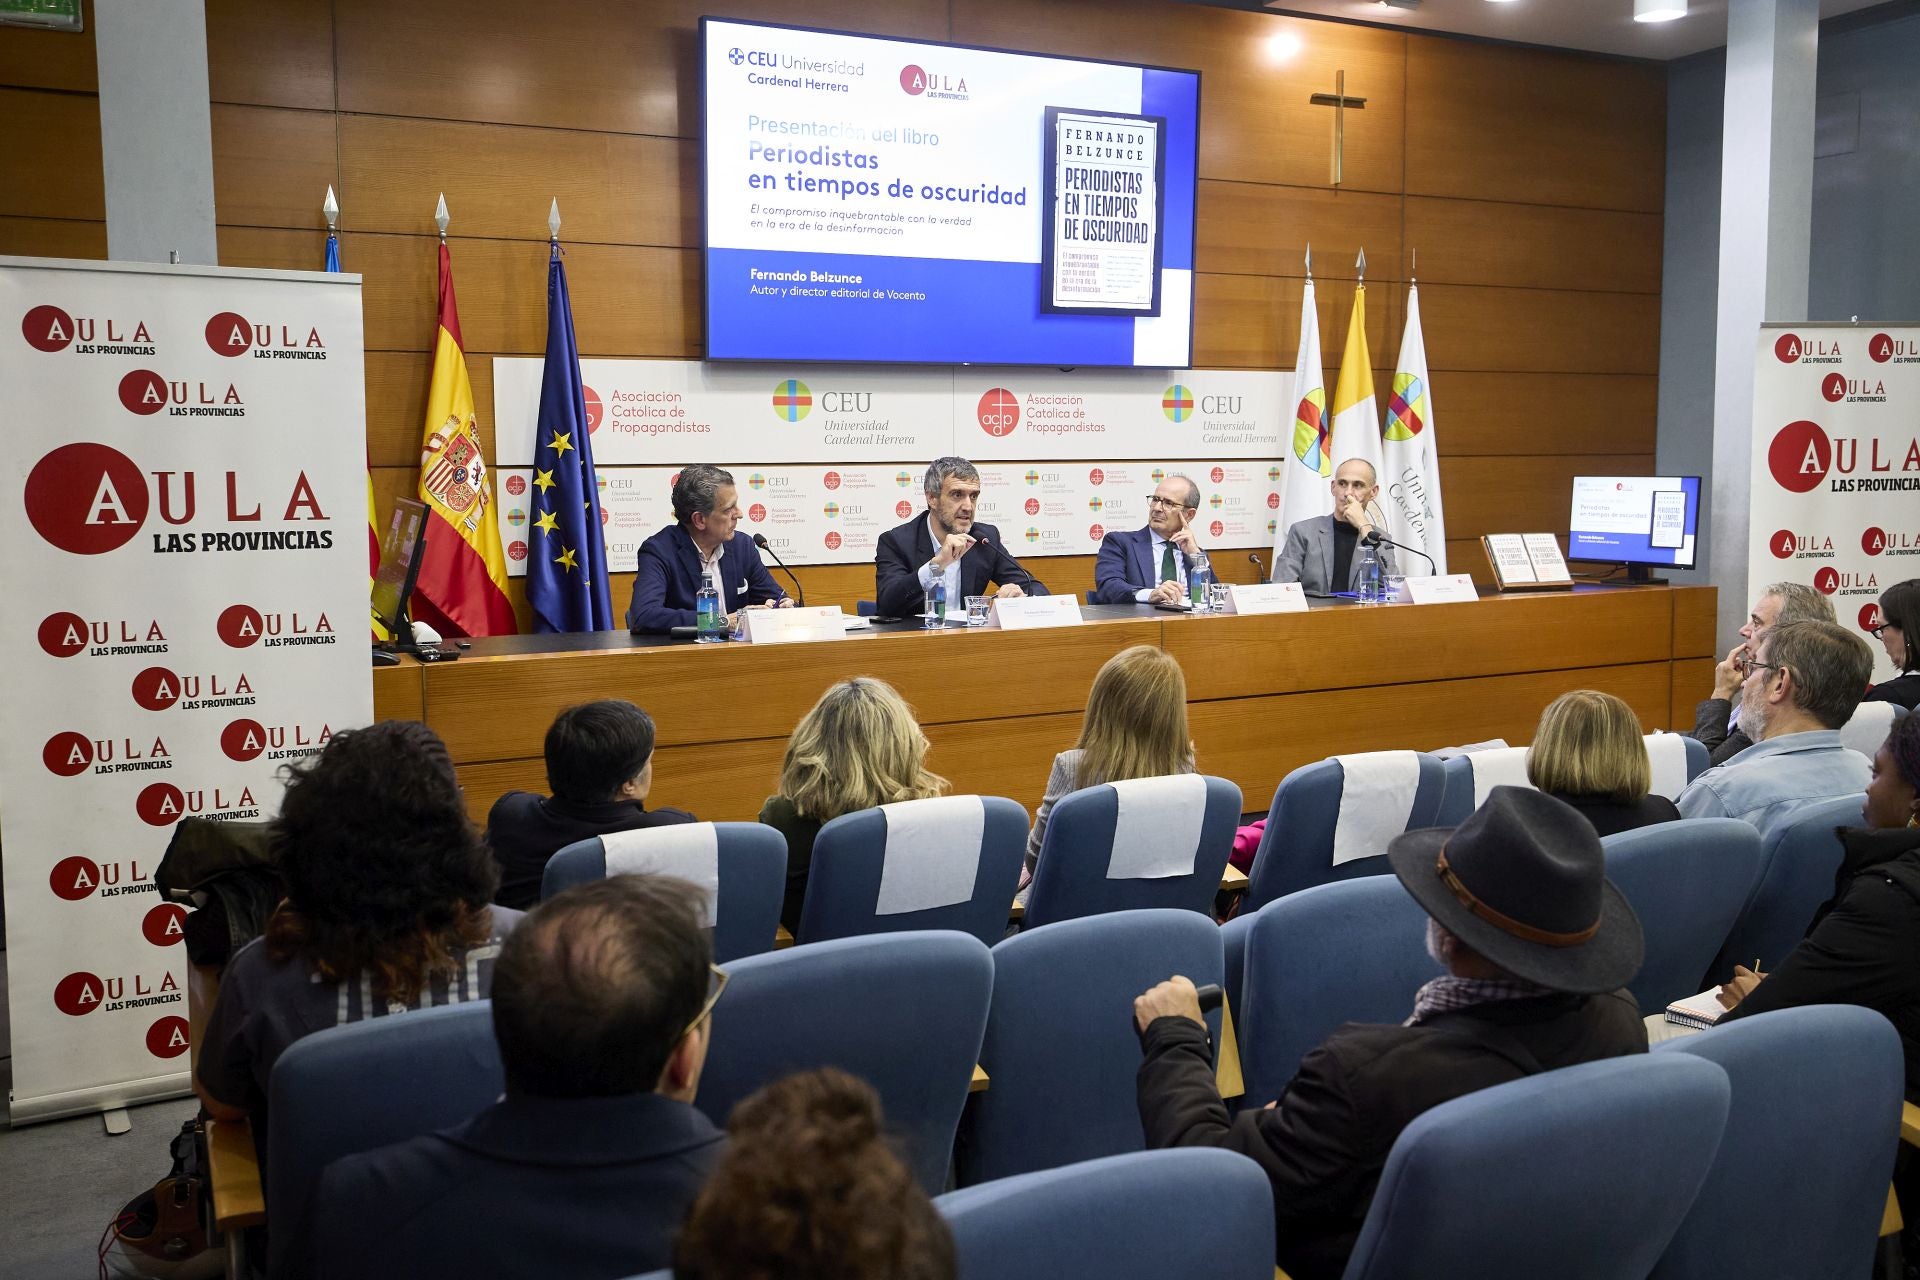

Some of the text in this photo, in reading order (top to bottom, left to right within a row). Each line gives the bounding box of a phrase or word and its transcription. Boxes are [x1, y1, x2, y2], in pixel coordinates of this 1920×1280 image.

[748, 51, 864, 76] CEU Universidad
[748, 73, 848, 93] Cardenal Herrera
[912, 72, 967, 92] AULA
[938, 92, 969, 101] PROVINCIAS
[748, 115, 939, 146] Presentación del libro
[1066, 128, 1144, 145] FERNANDO
[749, 141, 879, 169] Periodistas
[1066, 145, 1143, 161] BELZUNCE
[749, 170, 1027, 206] en tiempos de oscuridad
[1065, 167, 1143, 194] PERIODISTAS
[1065, 193, 1138, 219] EN TIEMPOS
[750, 204, 972, 227] El compromiso inquebrantable con la verdad
[750, 220, 763, 228] en
[766, 218, 776, 229] la
[799, 220, 811, 231] de
[814, 221, 823, 232] la
[1064, 218, 1148, 244] DE OSCURIDAD
[750, 268, 863, 284] Fernando Belzunce
[750, 285, 926, 301] Autor y director editorial de Vocento
[47, 317, 154, 343] AULA
[227, 323, 325, 348] AULA
[76, 345, 156, 356] LAS PROVINCIAS
[254, 350, 326, 360] LAS PROVINCIAS
[1787, 341, 1841, 356] AULA
[1880, 340, 1920, 356] AUL
[142, 381, 243, 405] AULA
[1832, 380, 1885, 395] AULA
[821, 391, 873, 413] CEU
[1201, 395, 1244, 415] CEU
[169, 407, 245, 417] LAS PROVINCIAS
[669, 406, 685, 418] de
[1072, 408, 1085, 418] de
[612, 421, 711, 436] Propagandistas
[824, 420, 890, 431] Universidad
[1026, 421, 1106, 435] Propagandistas
[1203, 420, 1256, 431] Universidad
[824, 433, 915, 445] Cardenal Herrera
[1202, 433, 1277, 443] Cardenal Herrera
[1799, 437, 1920, 474] AULA
[610, 479, 633, 489] CEU
[768, 477, 789, 486] CEU
[1041, 473, 1060, 482] CEU
[1831, 478, 1920, 492] LAS PROVINCIA
[85, 470, 330, 525] AULA
[1105, 500, 1122, 509] CEU
[842, 505, 862, 515] CEU
[977, 502, 996, 512] CEU
[153, 530, 333, 553] LAS PROVINCIAS
[1041, 530, 1060, 539] CEU
[1872, 533, 1920, 549] AULA
[612, 543, 634, 553] CEU
[769, 539, 790, 548] CEU
[1782, 536, 1833, 551] AULA
[1825, 572, 1878, 589] AULA
[238, 612, 335, 637] AULA
[61, 620, 167, 646] AULA
[264, 635, 336, 647] LAS PROVINCIAS
[90, 644, 169, 657] LAS PROVINCIAS
[155, 673, 255, 700] AULA
[182, 697, 256, 710] LAS PROVINCIAS
[242, 724, 334, 751] AULA
[66, 736, 171, 765] AULA
[267, 747, 324, 760] LAS PROVIN
[95, 760, 172, 775] LAS PROVINCIAS
[158, 786, 258, 815] AULA
[205, 809, 259, 822] PROVINCIAS
[73, 861, 148, 889] AUL
[101, 883, 159, 897] LAS PROVIN
[78, 970, 180, 1004] AULA
[105, 993, 182, 1012] LAS PROVINCIAS
